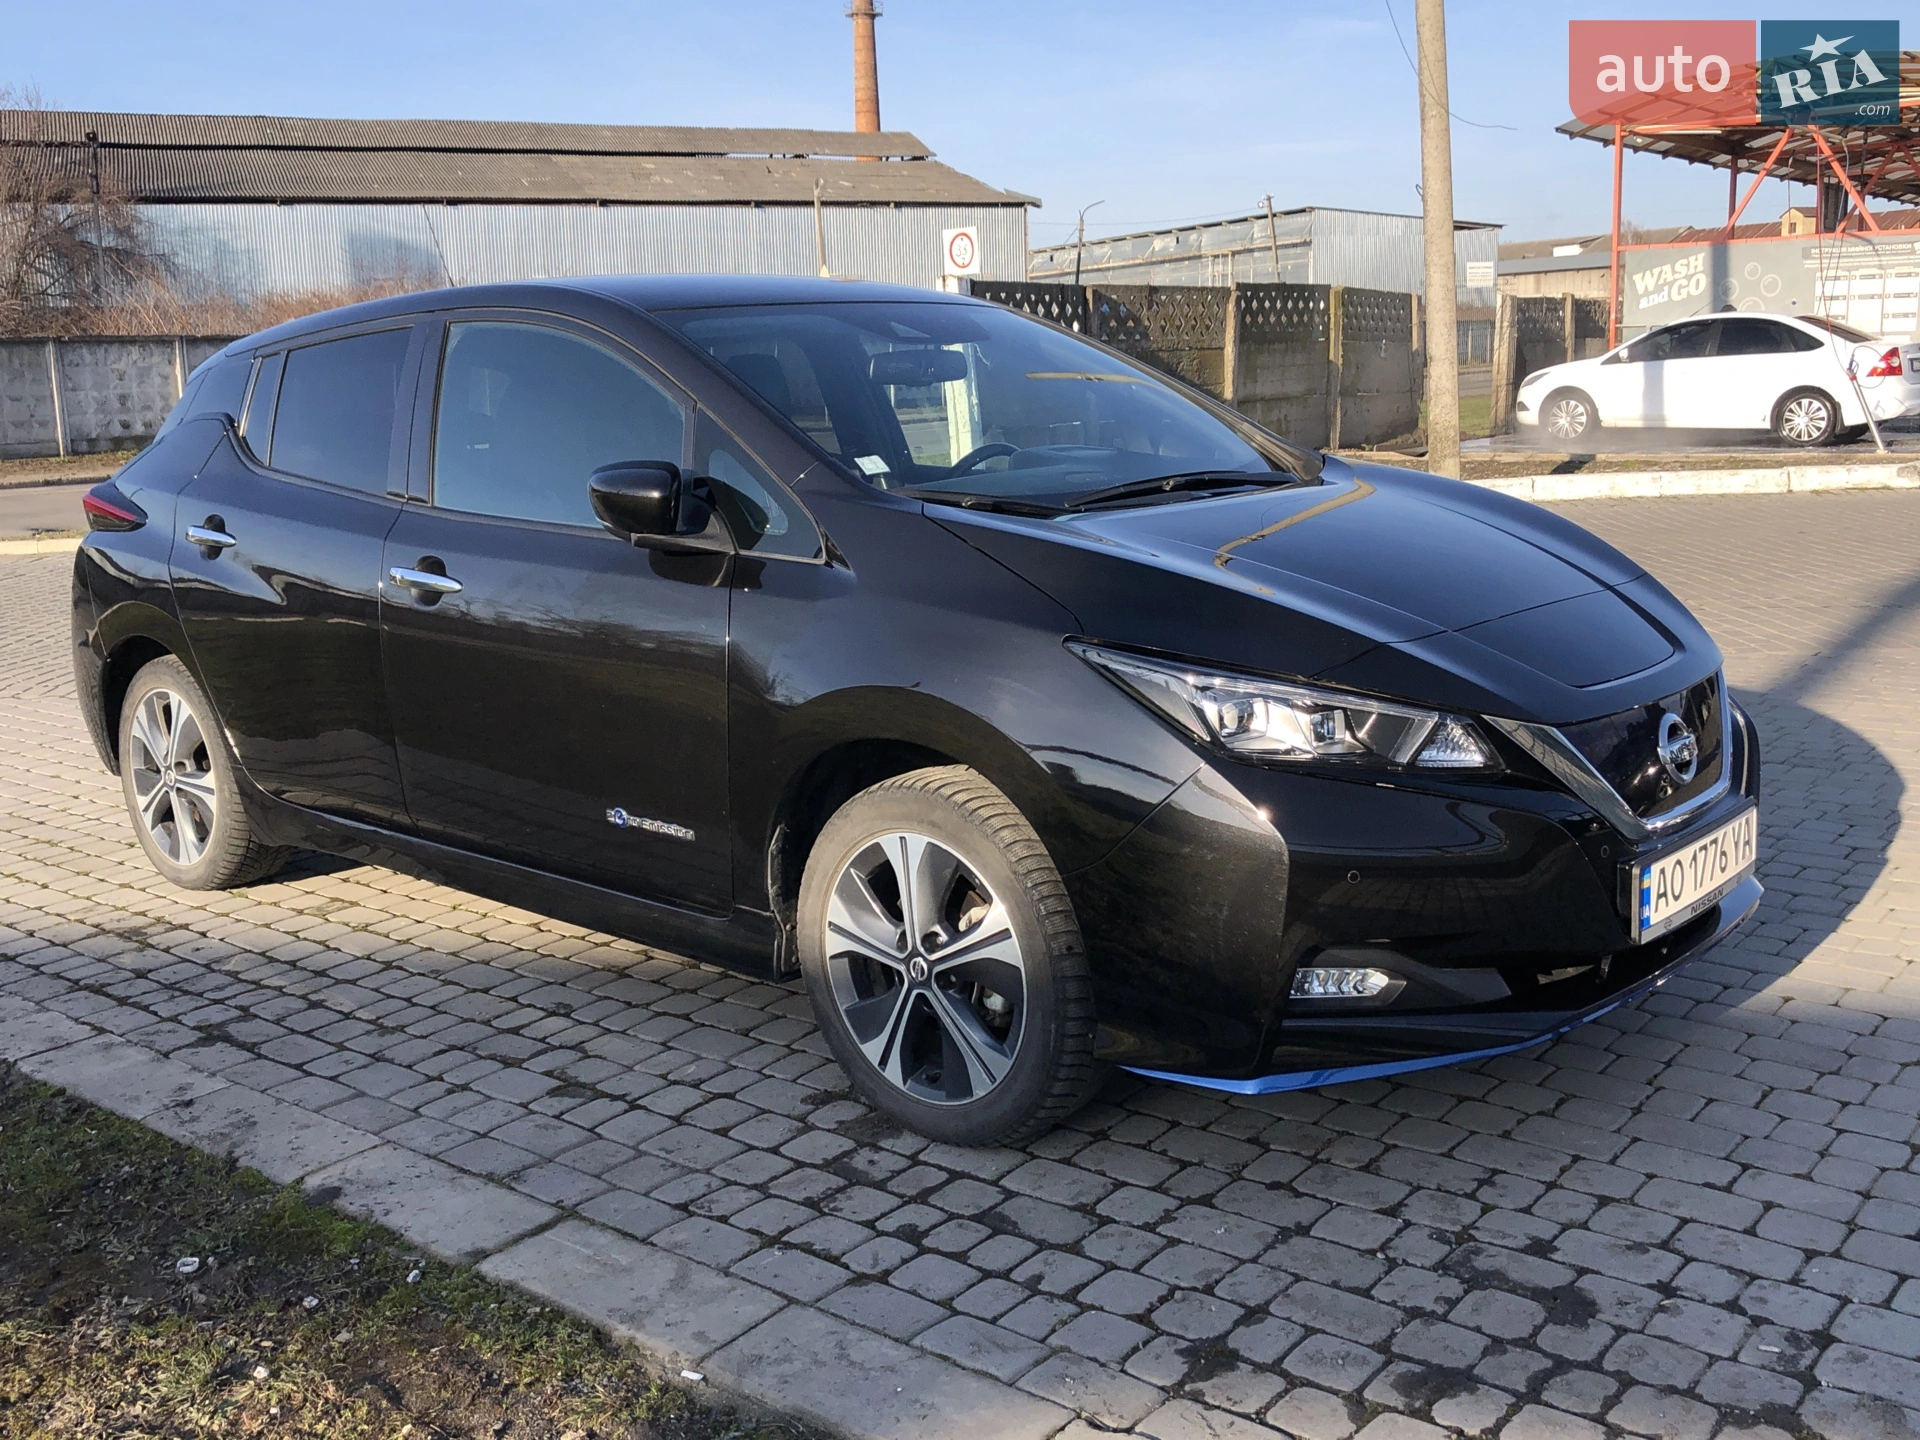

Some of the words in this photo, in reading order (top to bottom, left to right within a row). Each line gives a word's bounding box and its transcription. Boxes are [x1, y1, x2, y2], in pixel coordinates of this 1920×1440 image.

[1874, 243, 1912, 251] УСТАНОВКИ
[1632, 252, 1705, 295] WASH
[1638, 285, 1669, 310] and
[1670, 273, 1707, 302] GO
[1654, 858, 1685, 914] AO
[1688, 830, 1728, 892] 1776
[1731, 816, 1753, 867] YA
[1690, 887, 1725, 916] NISSAN
